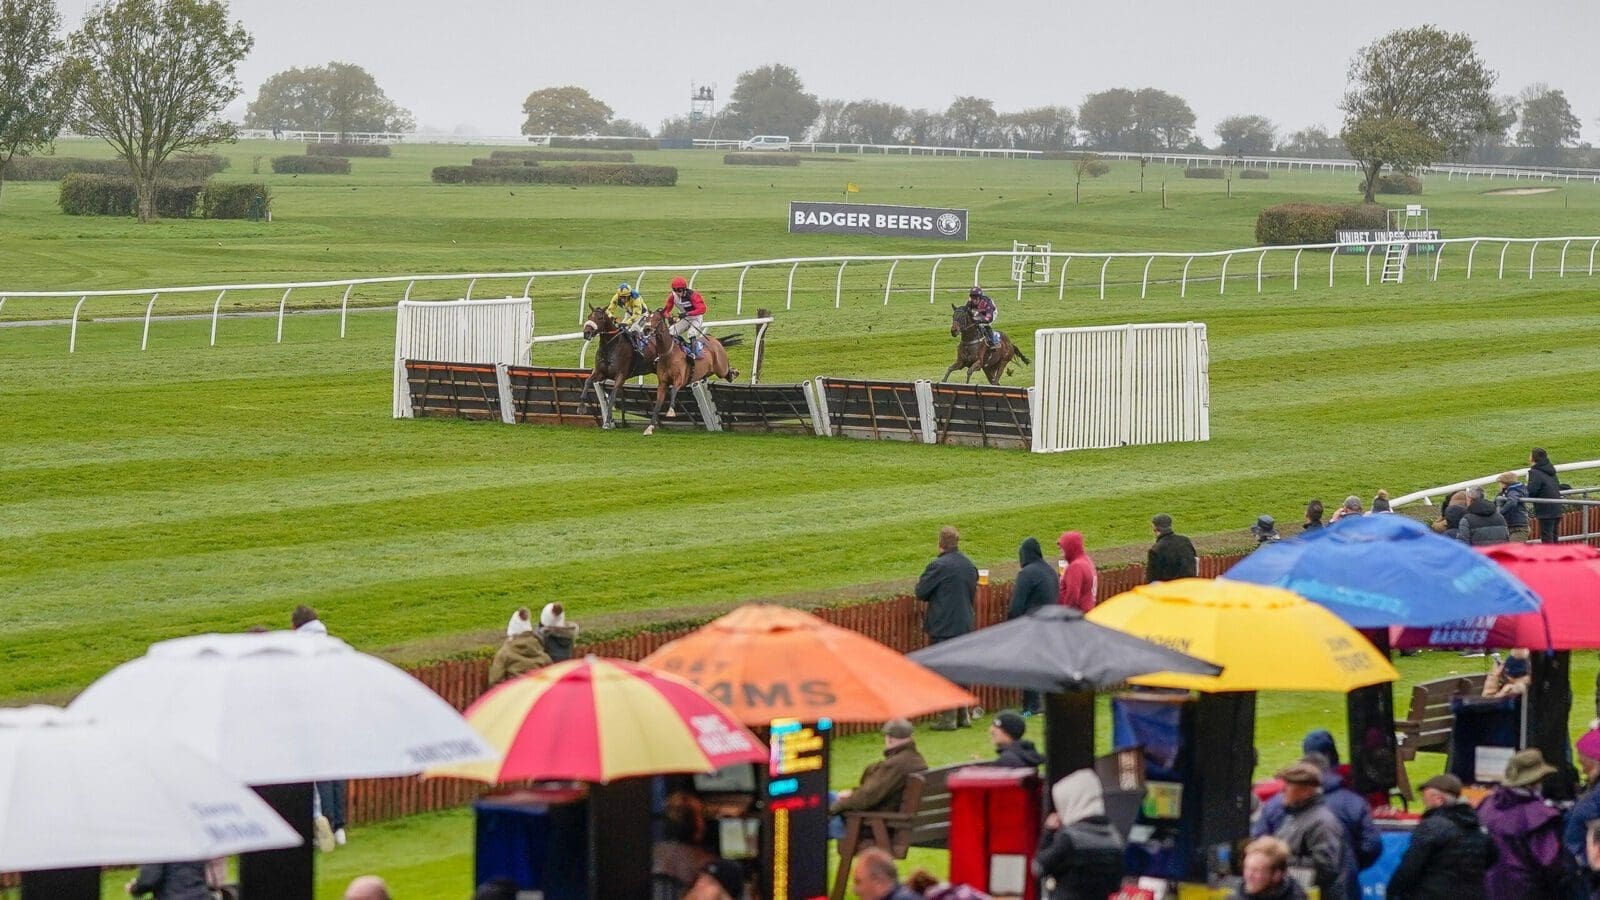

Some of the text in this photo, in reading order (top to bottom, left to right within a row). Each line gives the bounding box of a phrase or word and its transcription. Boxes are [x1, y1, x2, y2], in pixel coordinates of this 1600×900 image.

[794, 210, 870, 228] BADGER
[875, 213, 933, 231] BEERS
[1339, 231, 1370, 243] UNIBET
